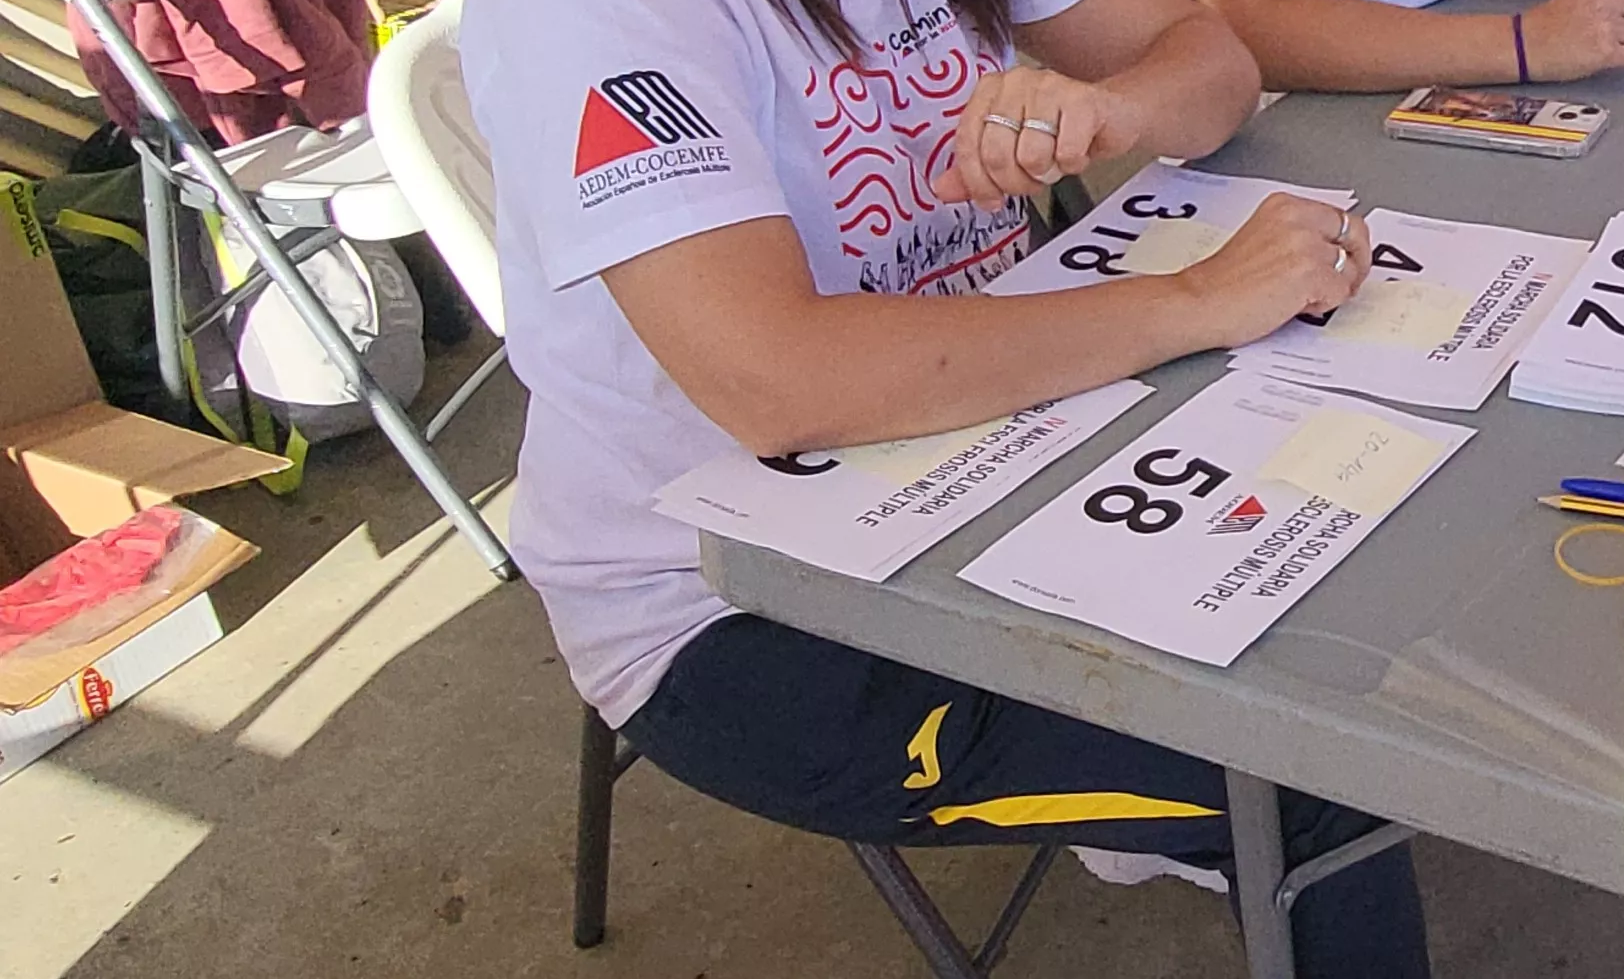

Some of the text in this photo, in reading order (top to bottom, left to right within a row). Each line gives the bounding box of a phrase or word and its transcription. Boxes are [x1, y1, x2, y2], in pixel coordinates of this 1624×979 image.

[578, 145, 730, 200] AEDEM-COCEMFE
[1060, 194, 1198, 276] 318
[1505, 254, 1534, 271] POR
[1461, 280, 1514, 325] ESCLEROSIS
[1508, 281, 1547, 310] MARCHA
[1472, 310, 1521, 349] SOLIDARIA
[991, 425, 1053, 464] MARCHA
[856, 477, 937, 527] MÚLTIPLE
[912, 463, 997, 516] SOLIDARIA
[1083, 448, 1232, 535] 58
[1251, 508, 1362, 598] RCHA SOLIDARIA
[1193, 556, 1268, 613] MÚLTIPLE
